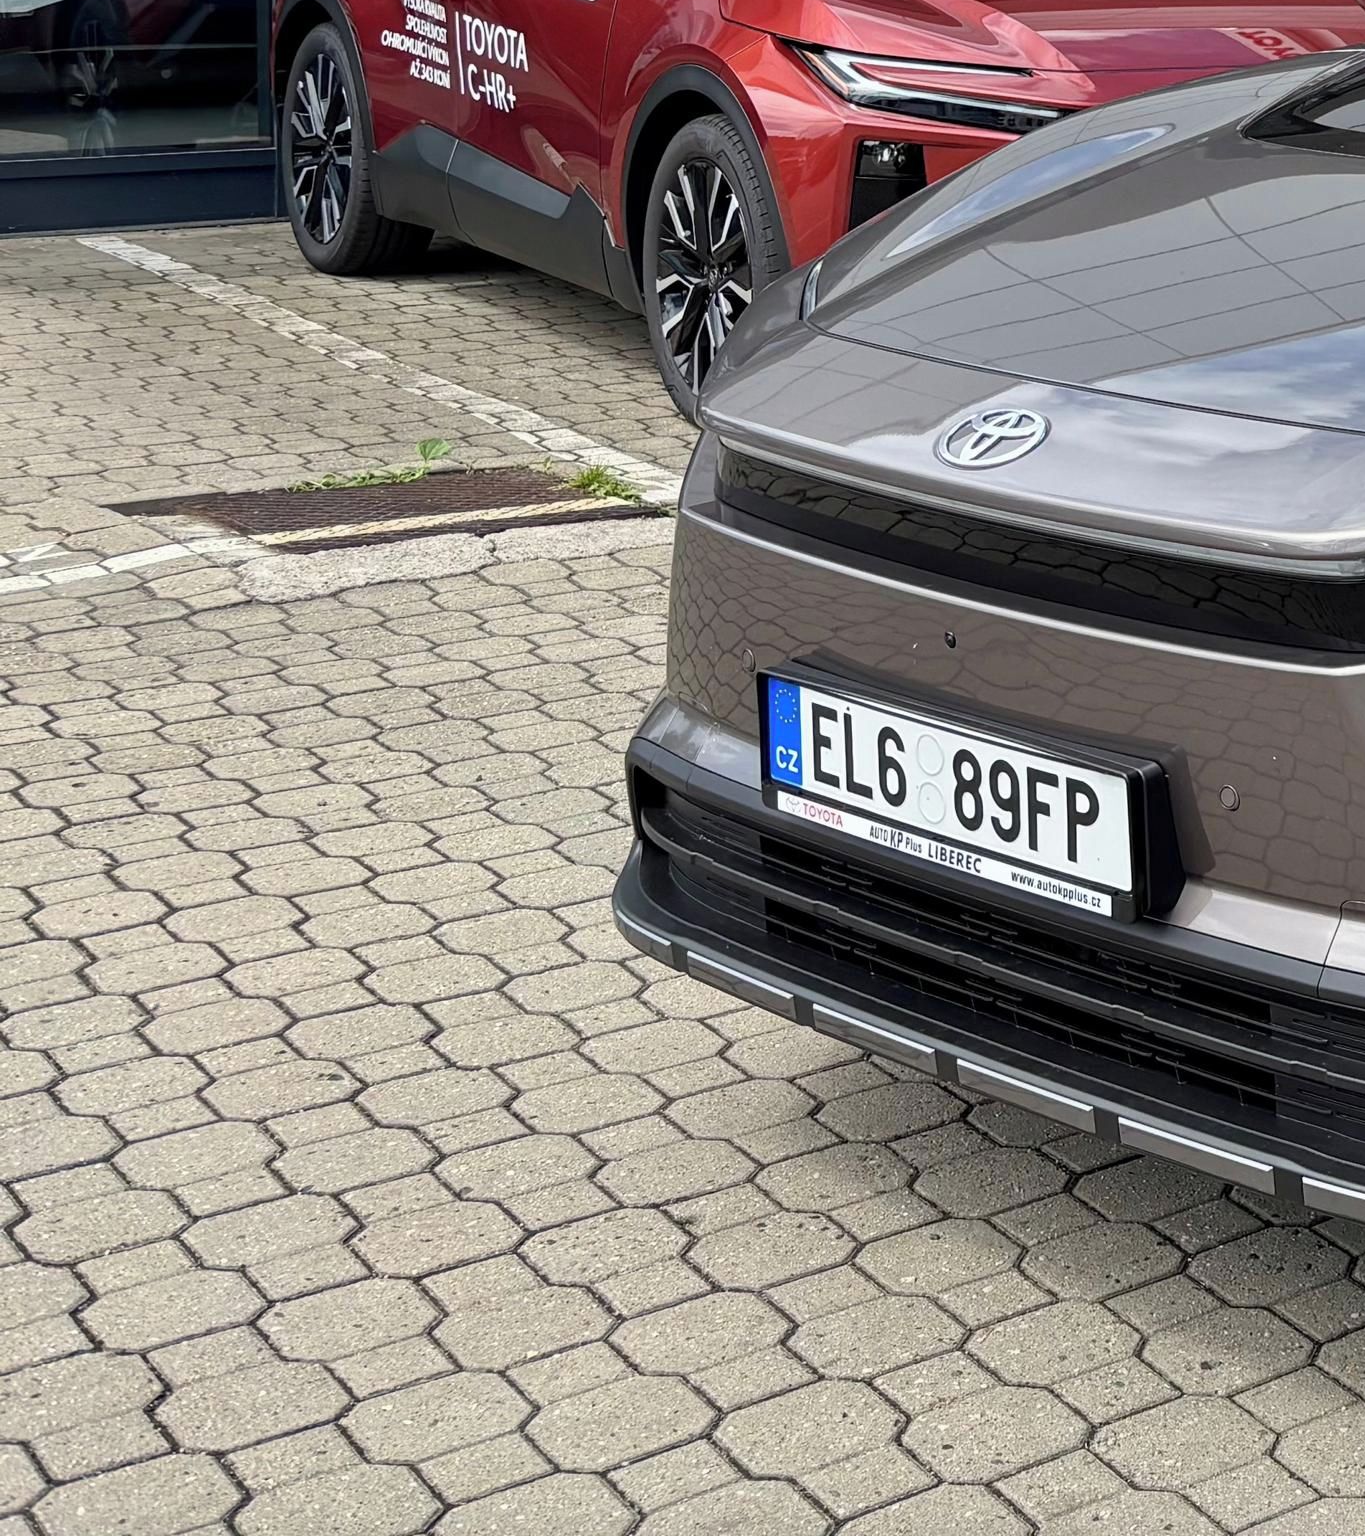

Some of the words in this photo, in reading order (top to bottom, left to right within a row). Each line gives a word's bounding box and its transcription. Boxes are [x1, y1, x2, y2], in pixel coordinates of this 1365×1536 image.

[463, 14, 529, 72] TOYOTA
[410, 58, 421, 77] AŽ
[467, 64, 517, 113] C-HR+
[776, 745, 799, 774] CZ
[812, 702, 907, 807] EL6
[953, 749, 1099, 863] 89FP
[802, 802, 843, 828] TOYOTA
[869, 825, 889, 842] AUTO
[890, 829, 904, 849] KP
[905, 837, 922, 854] Plus
[928, 843, 982, 874] LIBEREC
[1011, 871, 1102, 909] www.autokpplus.cz
